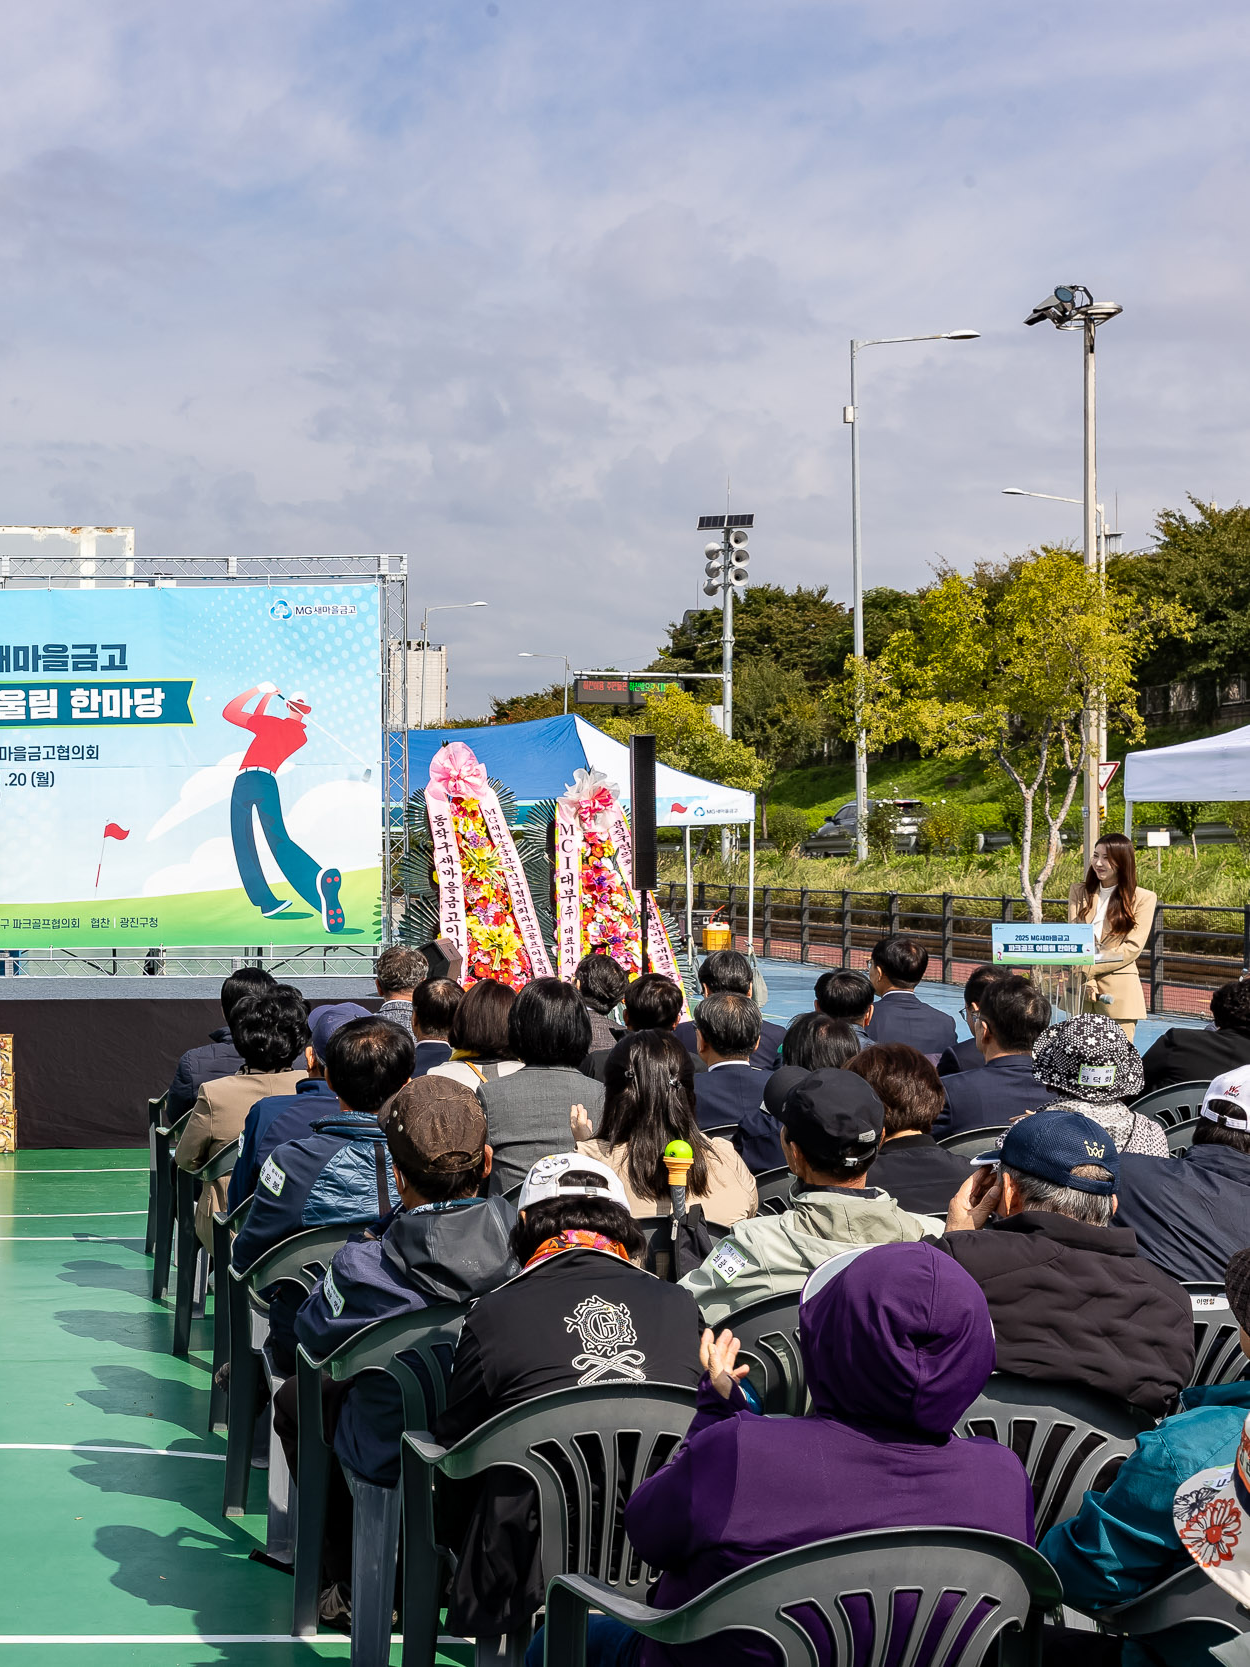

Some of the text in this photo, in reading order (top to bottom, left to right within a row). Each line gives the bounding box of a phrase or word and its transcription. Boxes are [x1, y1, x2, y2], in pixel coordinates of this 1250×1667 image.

[69, 687, 166, 720] 한마당
[31, 771, 56, 788] (월)
[12, 917, 80, 930] 파크골프협의회
[91, 917, 110, 929] 협찬
[119, 916, 159, 929] 광진구청
[1014, 934, 1030, 942] 2025
